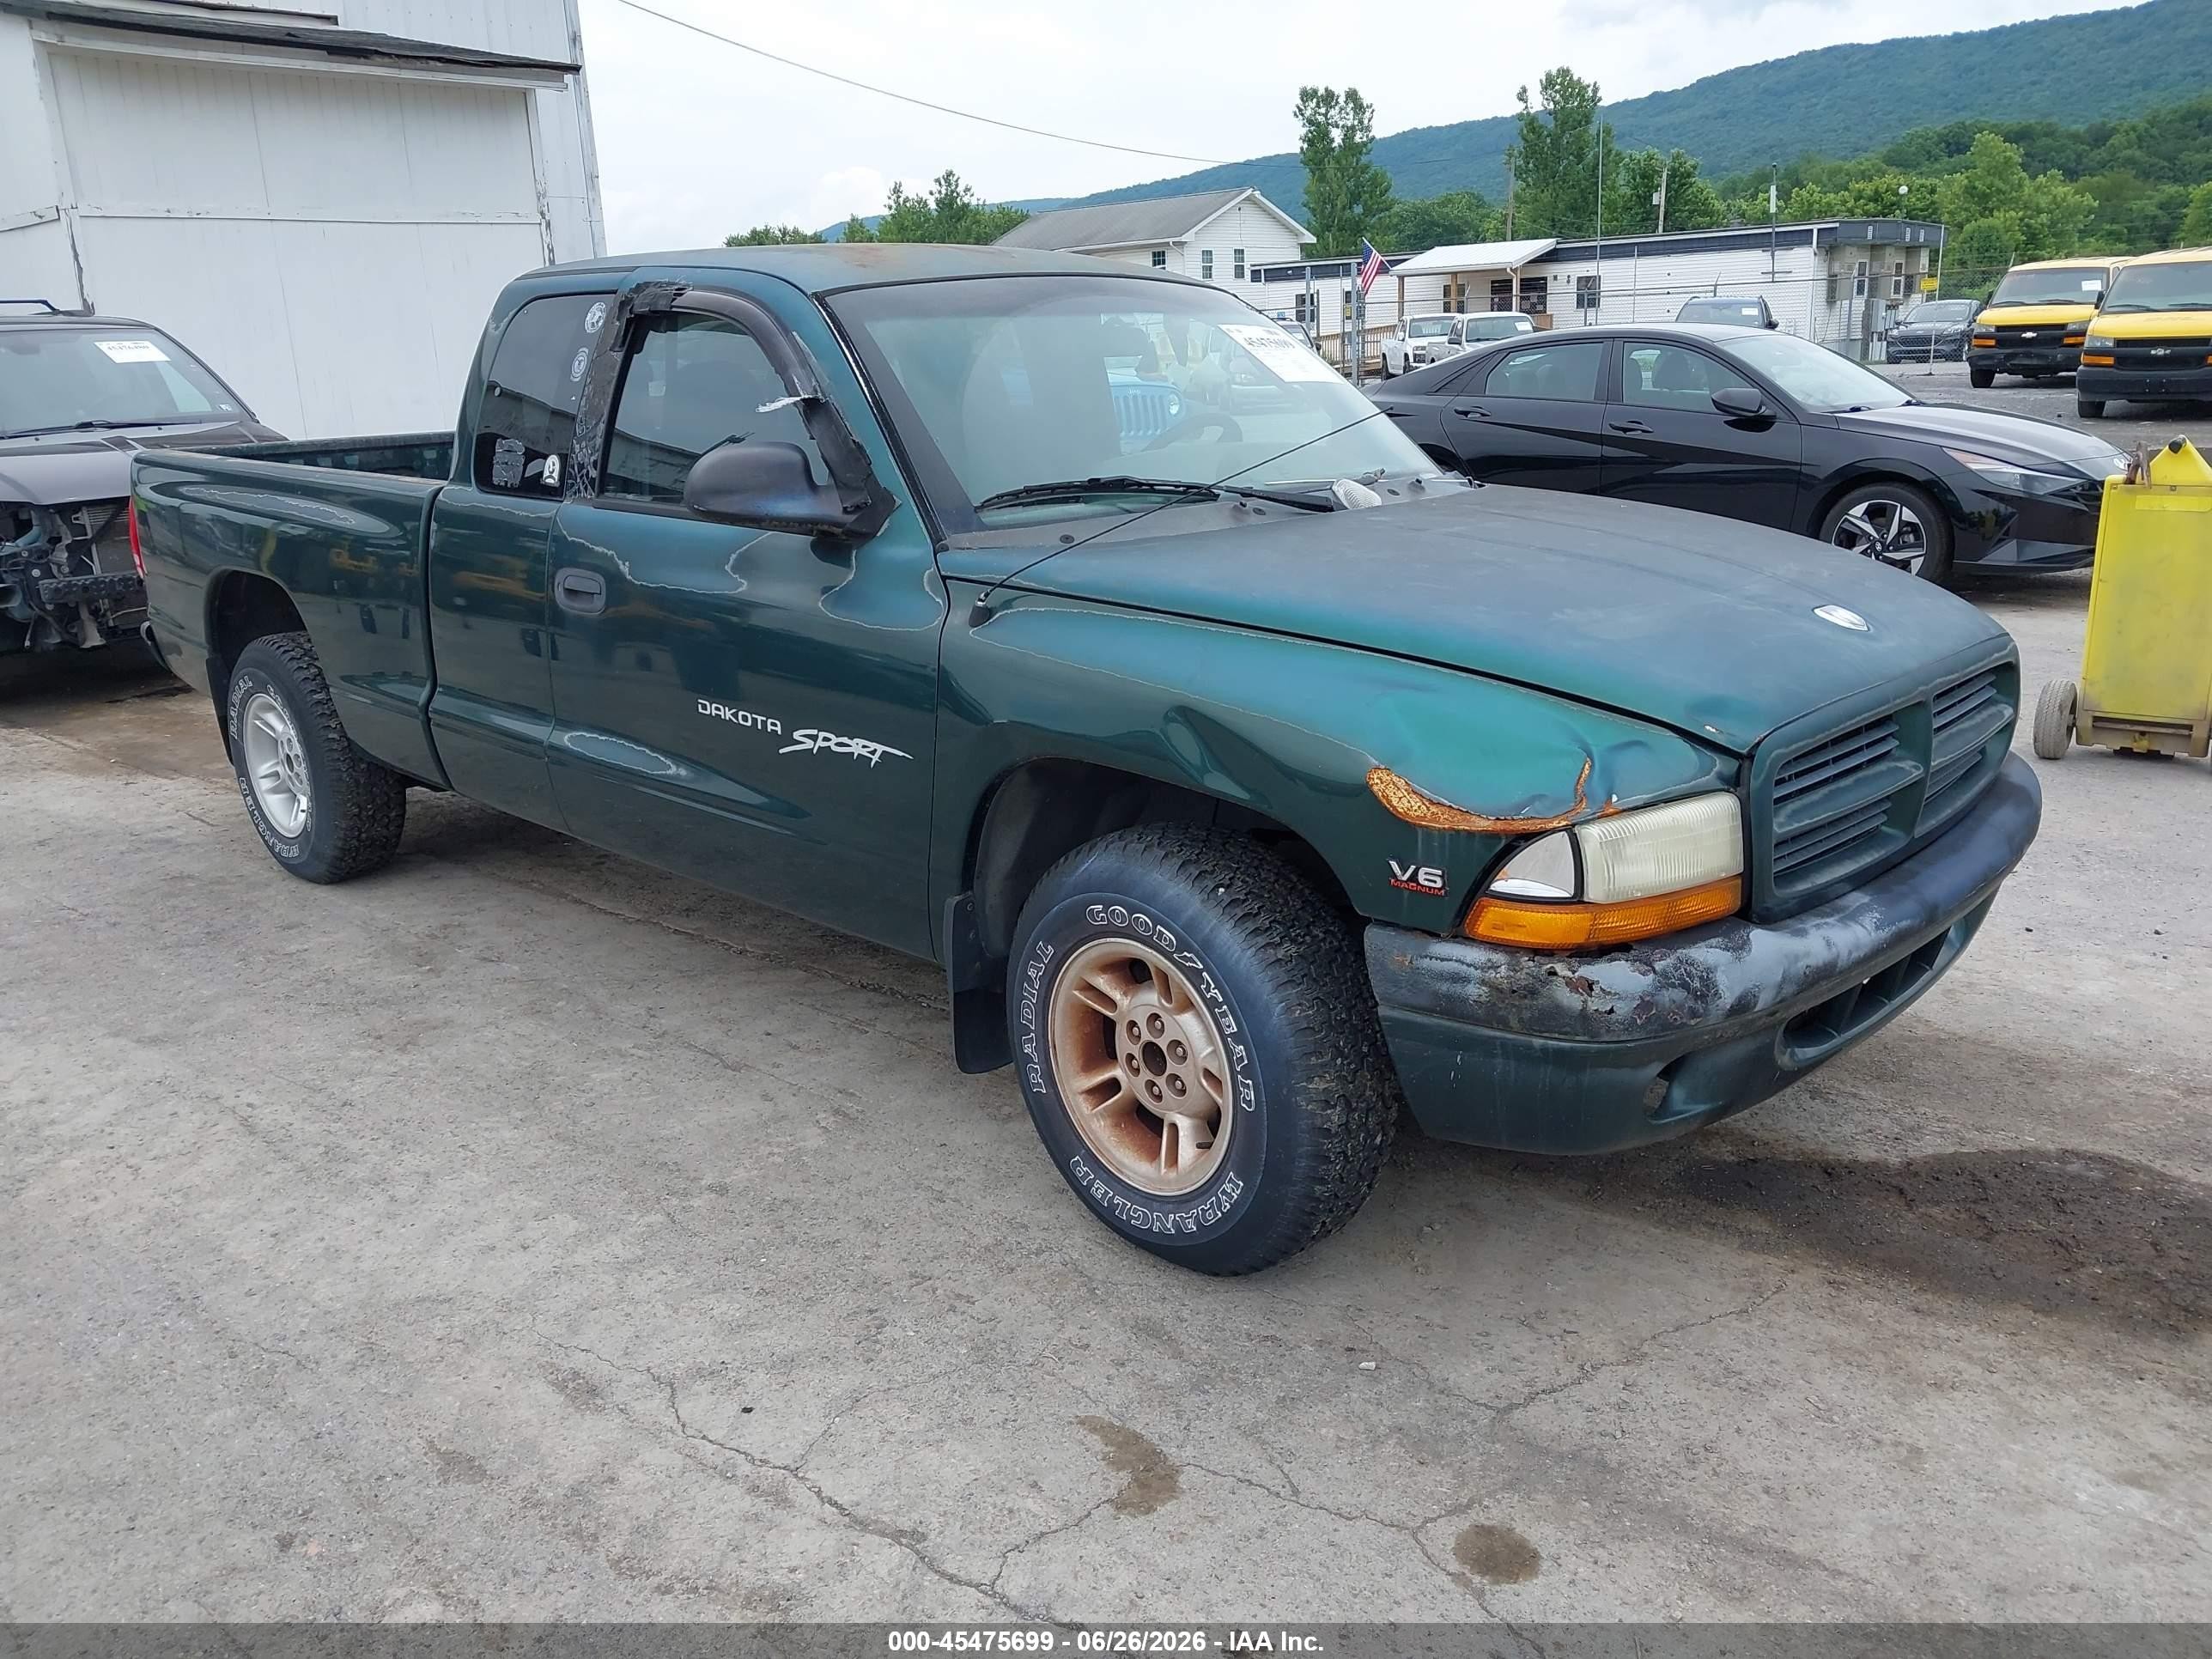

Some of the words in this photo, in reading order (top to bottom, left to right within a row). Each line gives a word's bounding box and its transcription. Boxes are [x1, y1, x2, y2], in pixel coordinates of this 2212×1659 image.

[229, 675, 253, 740] RADIAL
[697, 699, 782, 735] DAKOTA
[778, 729, 915, 769] SPORT
[239, 777, 300, 858] WRANGLER
[1388, 860, 1444, 889] V6
[1389, 878, 1446, 896] MAGNUM
[1020, 940, 1055, 1094] RADIAL
[1068, 1154, 1244, 1235] WRANGLER
